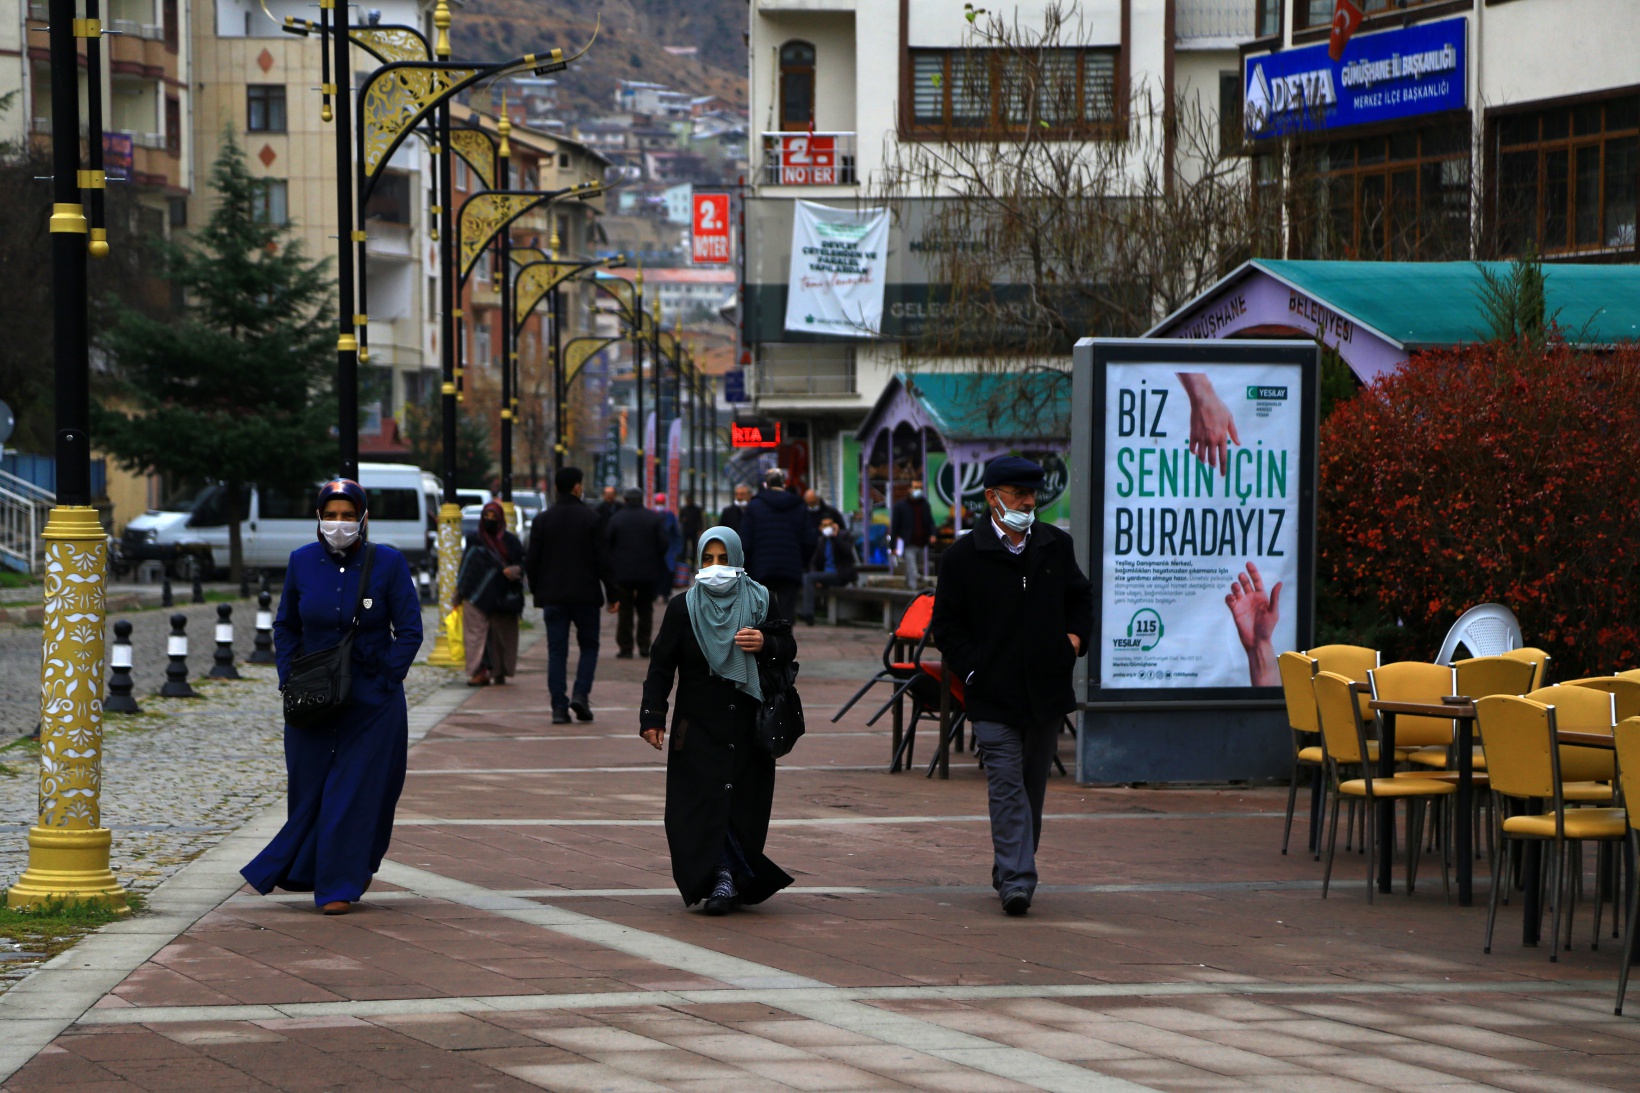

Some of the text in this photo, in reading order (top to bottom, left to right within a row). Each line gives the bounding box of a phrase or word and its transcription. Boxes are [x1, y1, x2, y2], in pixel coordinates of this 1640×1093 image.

[1341, 43, 1457, 89] GÜMÜŞHANE İL BAŞKANLIĞI
[1271, 68, 1337, 113] DEVA
[1353, 80, 1450, 110] MERKEZ İLÇE BAŞKANLIĞI
[789, 138, 829, 164] 2.
[700, 201, 723, 229] 2.
[694, 235, 728, 257] NOTER
[1118, 379, 1169, 438] BİZ
[1116, 438, 1214, 498] SENİN
[1224, 438, 1287, 506] İÇİN
[1115, 507, 1286, 557] BURADAYIZ
[1136, 620, 1157, 633] 115
